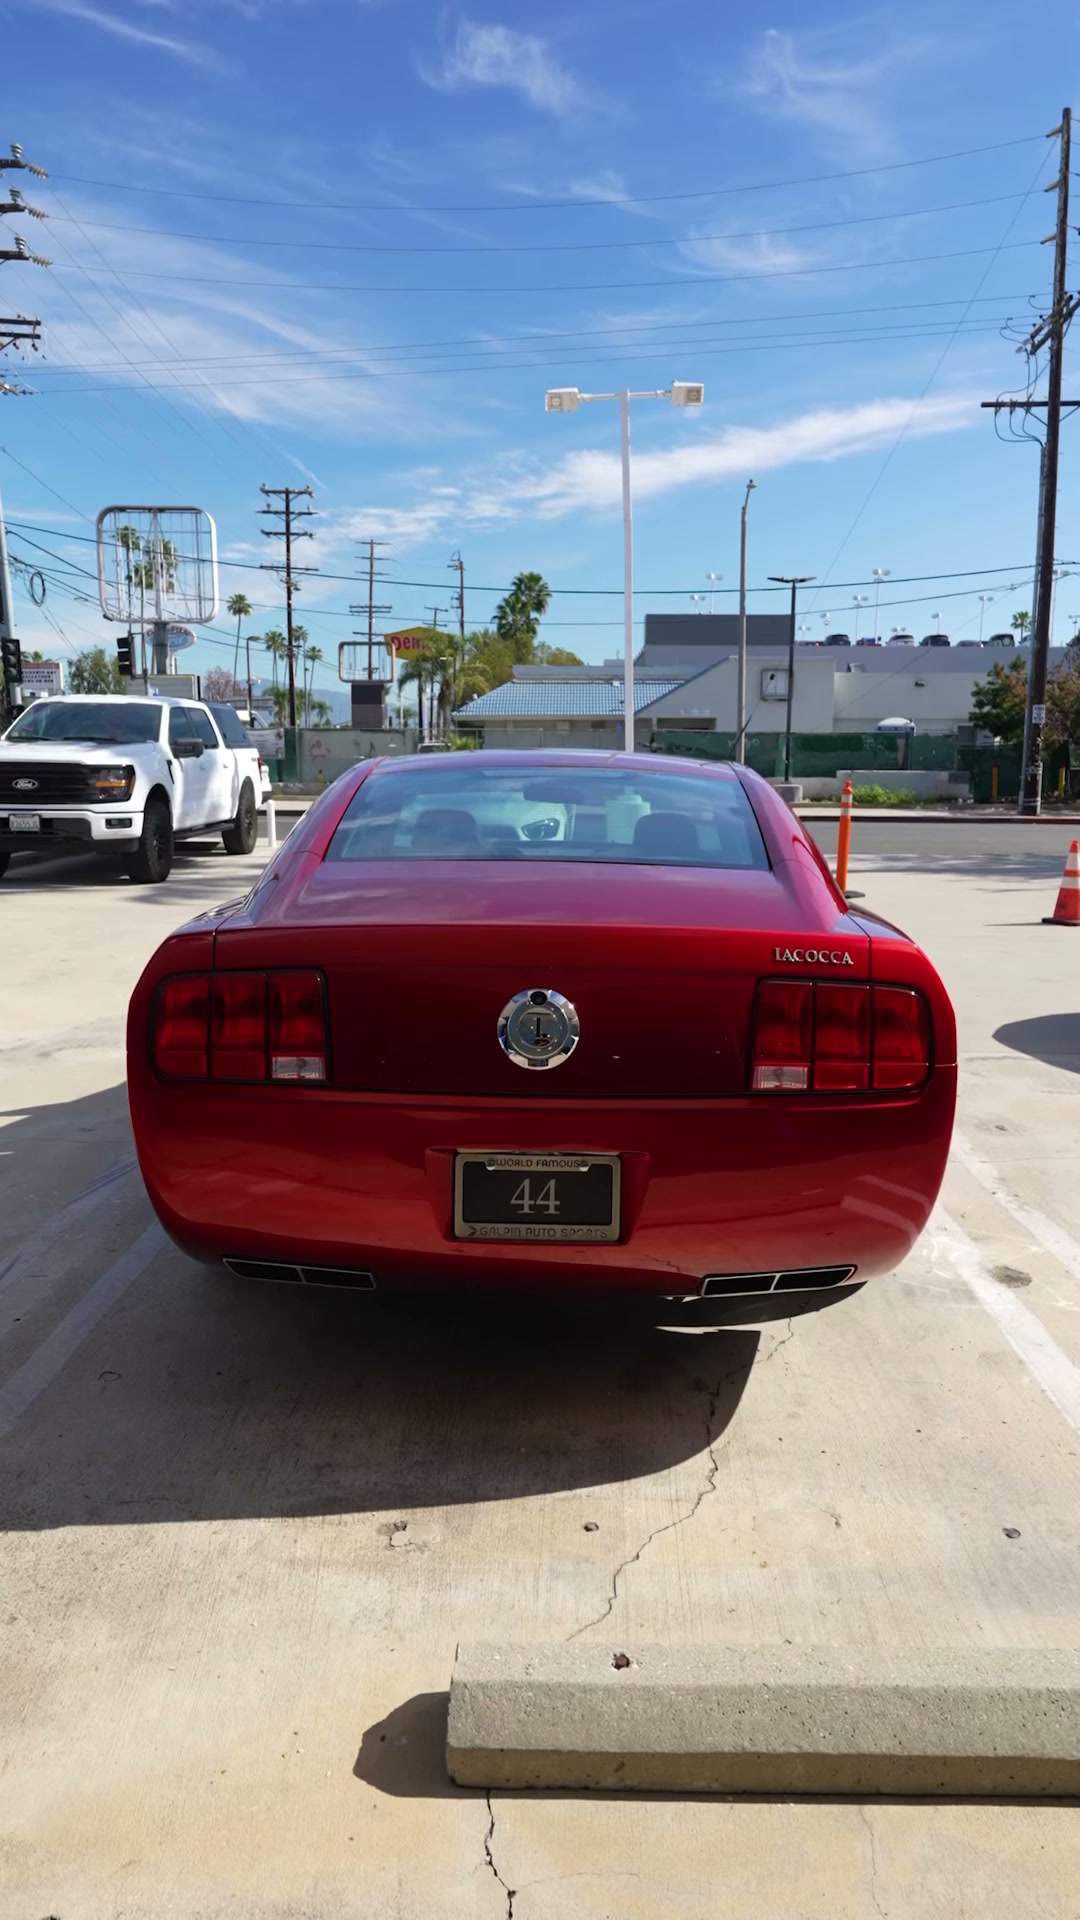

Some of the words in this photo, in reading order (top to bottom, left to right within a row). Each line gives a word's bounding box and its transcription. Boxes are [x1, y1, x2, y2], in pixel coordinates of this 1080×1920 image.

[774, 947, 854, 965] IACOCCA
[496, 1159, 533, 1168] WORLD
[536, 1159, 580, 1169] FAMOUS
[510, 1177, 561, 1215] 44
[480, 1226, 521, 1237] GALPIN
[526, 1227, 557, 1238] AUTO
[560, 1228, 608, 1239] SPORTS
